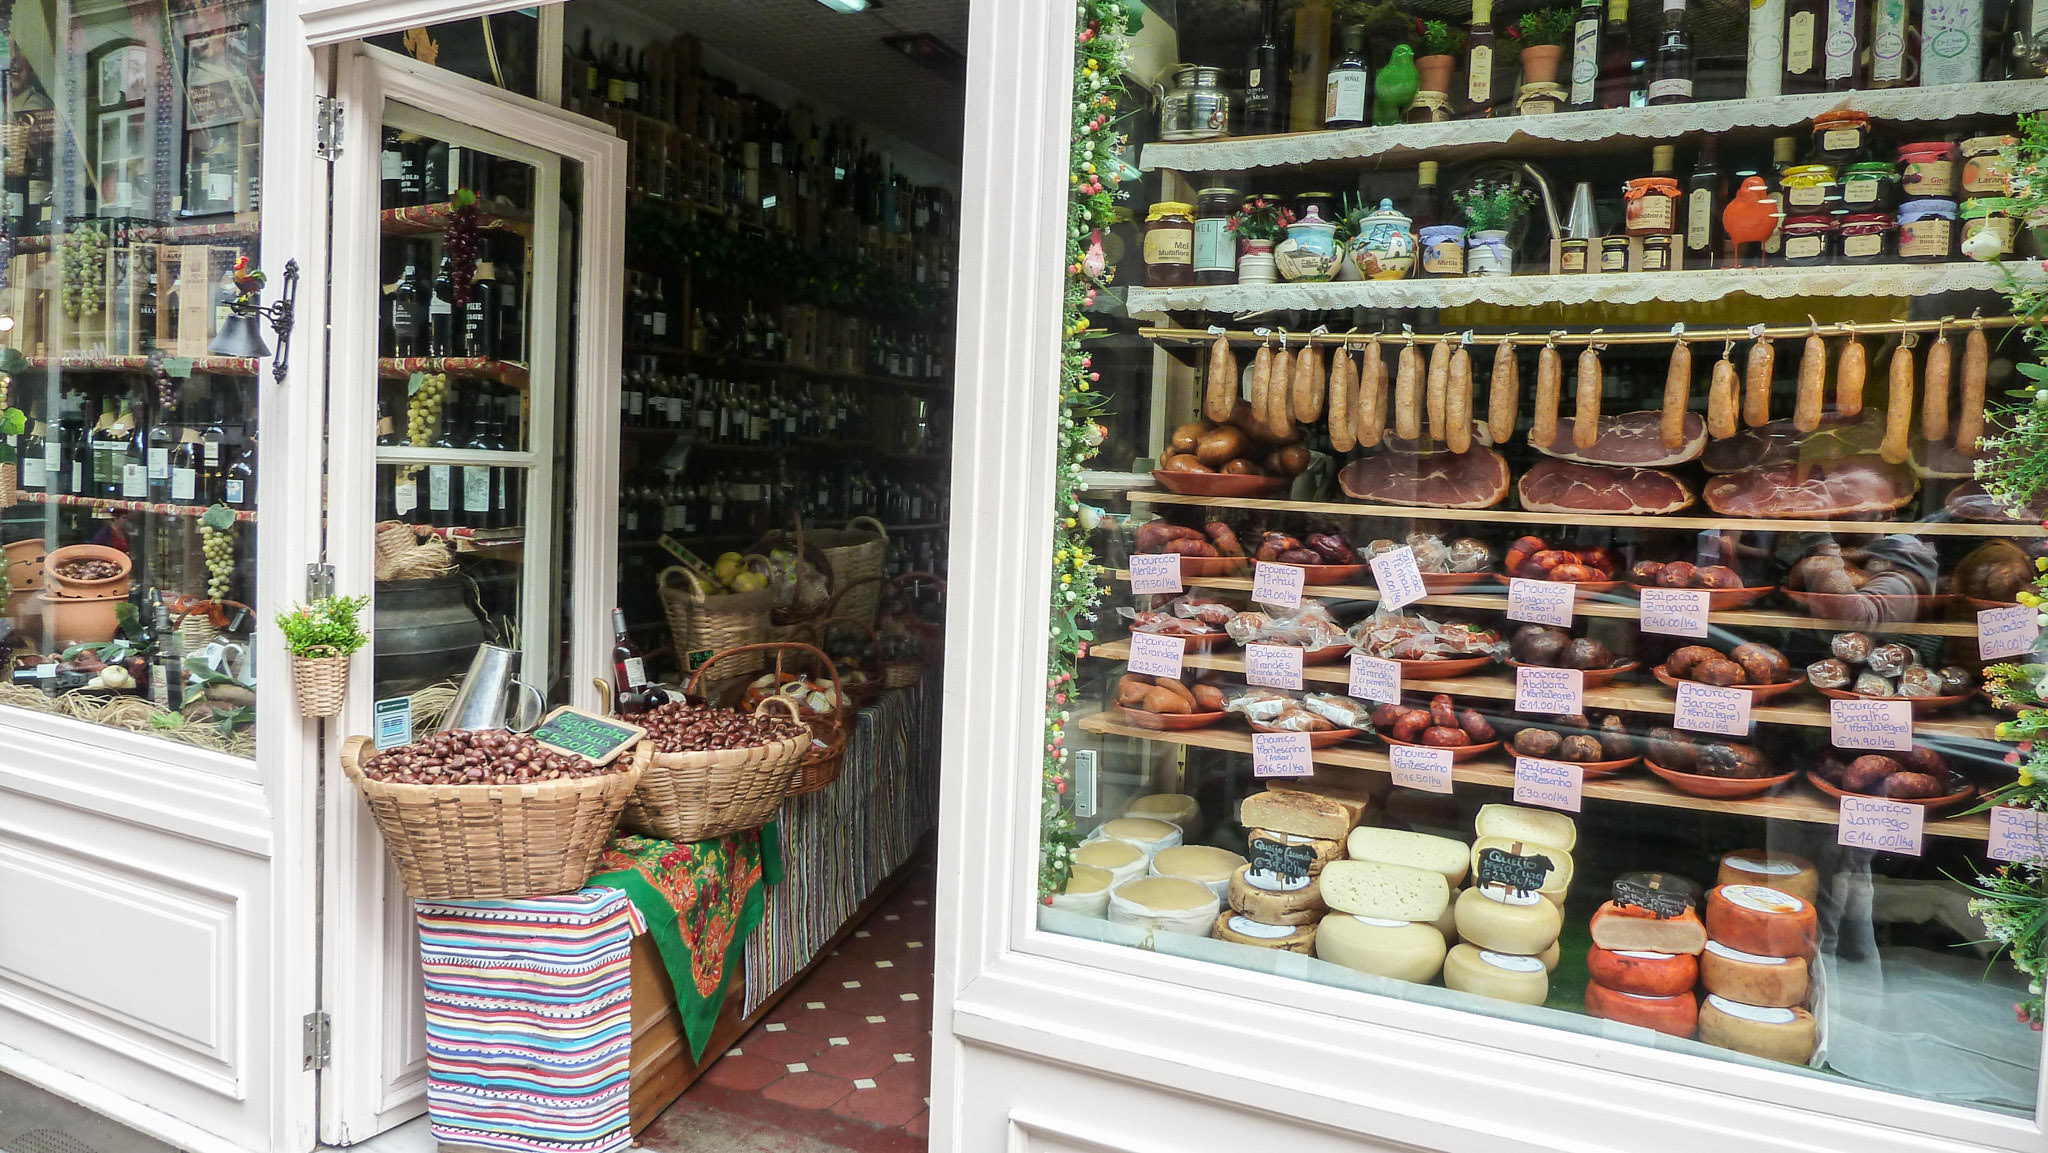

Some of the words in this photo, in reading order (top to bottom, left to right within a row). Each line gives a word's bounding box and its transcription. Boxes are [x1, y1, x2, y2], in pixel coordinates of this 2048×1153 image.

[1643, 616, 1699, 631] €40.00/kg
[1249, 645, 1294, 660] Salpicão
[1130, 660, 1177, 677] €22.50/kg
[1521, 668, 1570, 681] Chouriço
[1680, 683, 1742, 700] Chouriço
[1681, 696, 1737, 711] Barroso
[1832, 700, 1889, 711] Chouriço
[1256, 734, 1297, 746] Chouriço
[1837, 735, 1897, 749] €14.90/kg
[1256, 761, 1305, 775] €16.50/kg
[1519, 758, 1570, 777] Salpicão
[1516, 786, 1569, 805] €30.00/kg
[1843, 798, 1912, 815] Chouriço
[1846, 812, 1910, 832] Lamego
[1844, 830, 1914, 851] €14.00/kg
